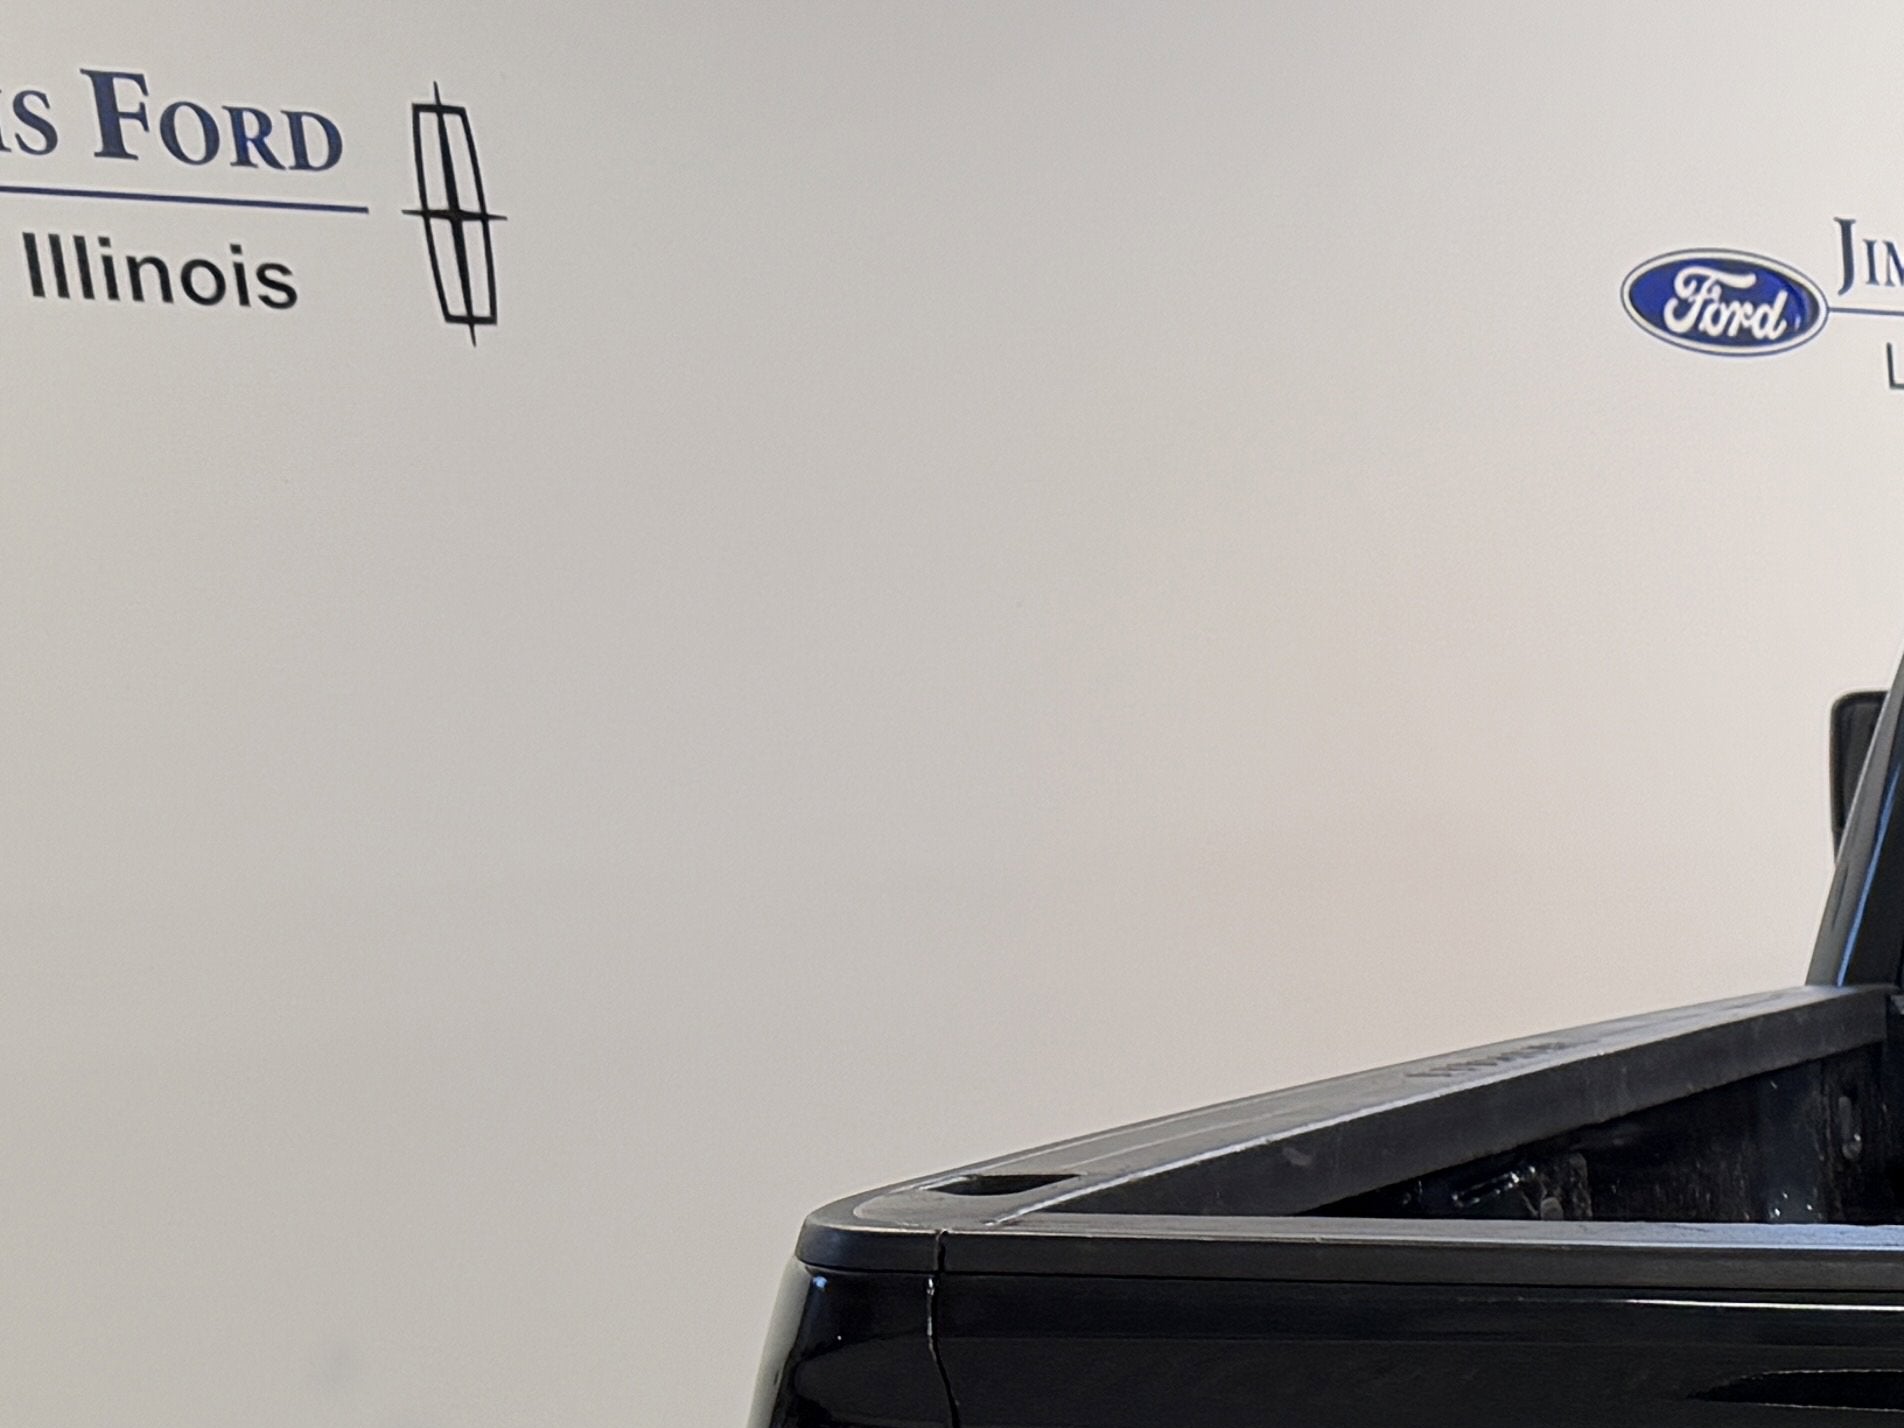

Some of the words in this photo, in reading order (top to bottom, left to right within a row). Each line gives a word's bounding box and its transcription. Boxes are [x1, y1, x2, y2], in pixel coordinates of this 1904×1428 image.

[80, 68, 343, 172] FORD
[22, 231, 298, 310] Illinois
[1663, 266, 1788, 340] Ford
